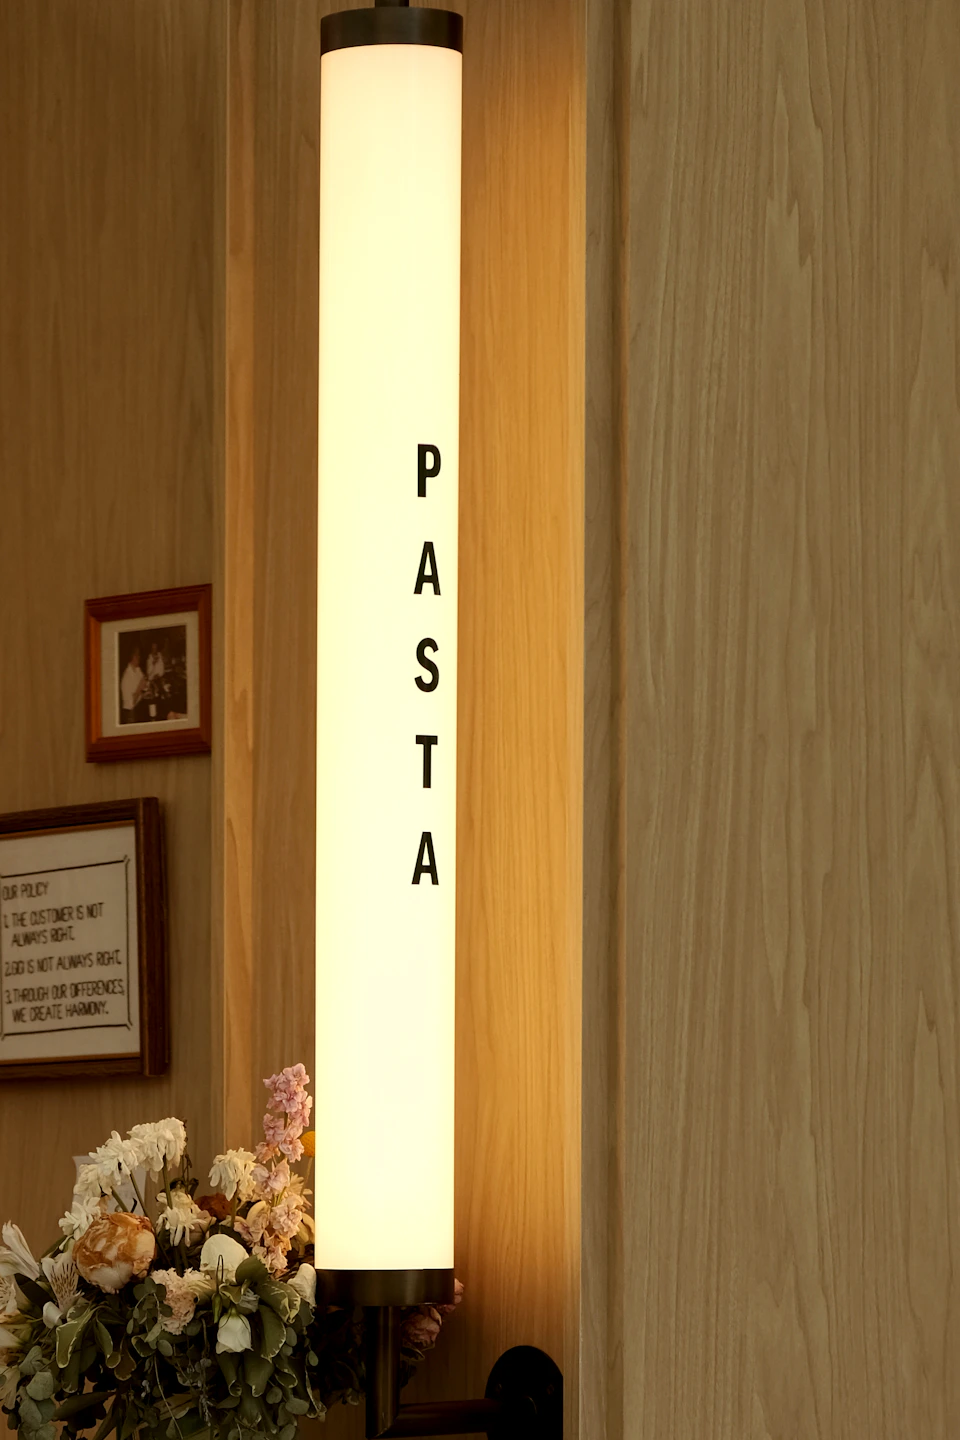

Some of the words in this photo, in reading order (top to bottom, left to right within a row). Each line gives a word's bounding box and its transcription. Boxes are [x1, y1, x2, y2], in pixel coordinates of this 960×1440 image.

[411, 443, 441, 886] PASTA
[2, 883, 17, 900] OUR
[20, 881, 50, 897] POLICY
[12, 911, 27, 927] THE
[30, 906, 74, 926] CUSTOMER
[76, 904, 84, 919] IS
[86, 902, 104, 918] NOT
[11, 929, 47, 947] ALWAYS
[27, 959, 35, 973] IS
[37, 956, 54, 972] NOT
[56, 952, 93, 970] ALWAYS
[51, 983, 67, 1000] OUR
[70, 978, 125, 997] DIFFERENCES,
[12, 1007, 27, 1023] WE
[29, 1003, 62, 1022] CREATE
[65, 1000, 109, 1020] HARMONY.
